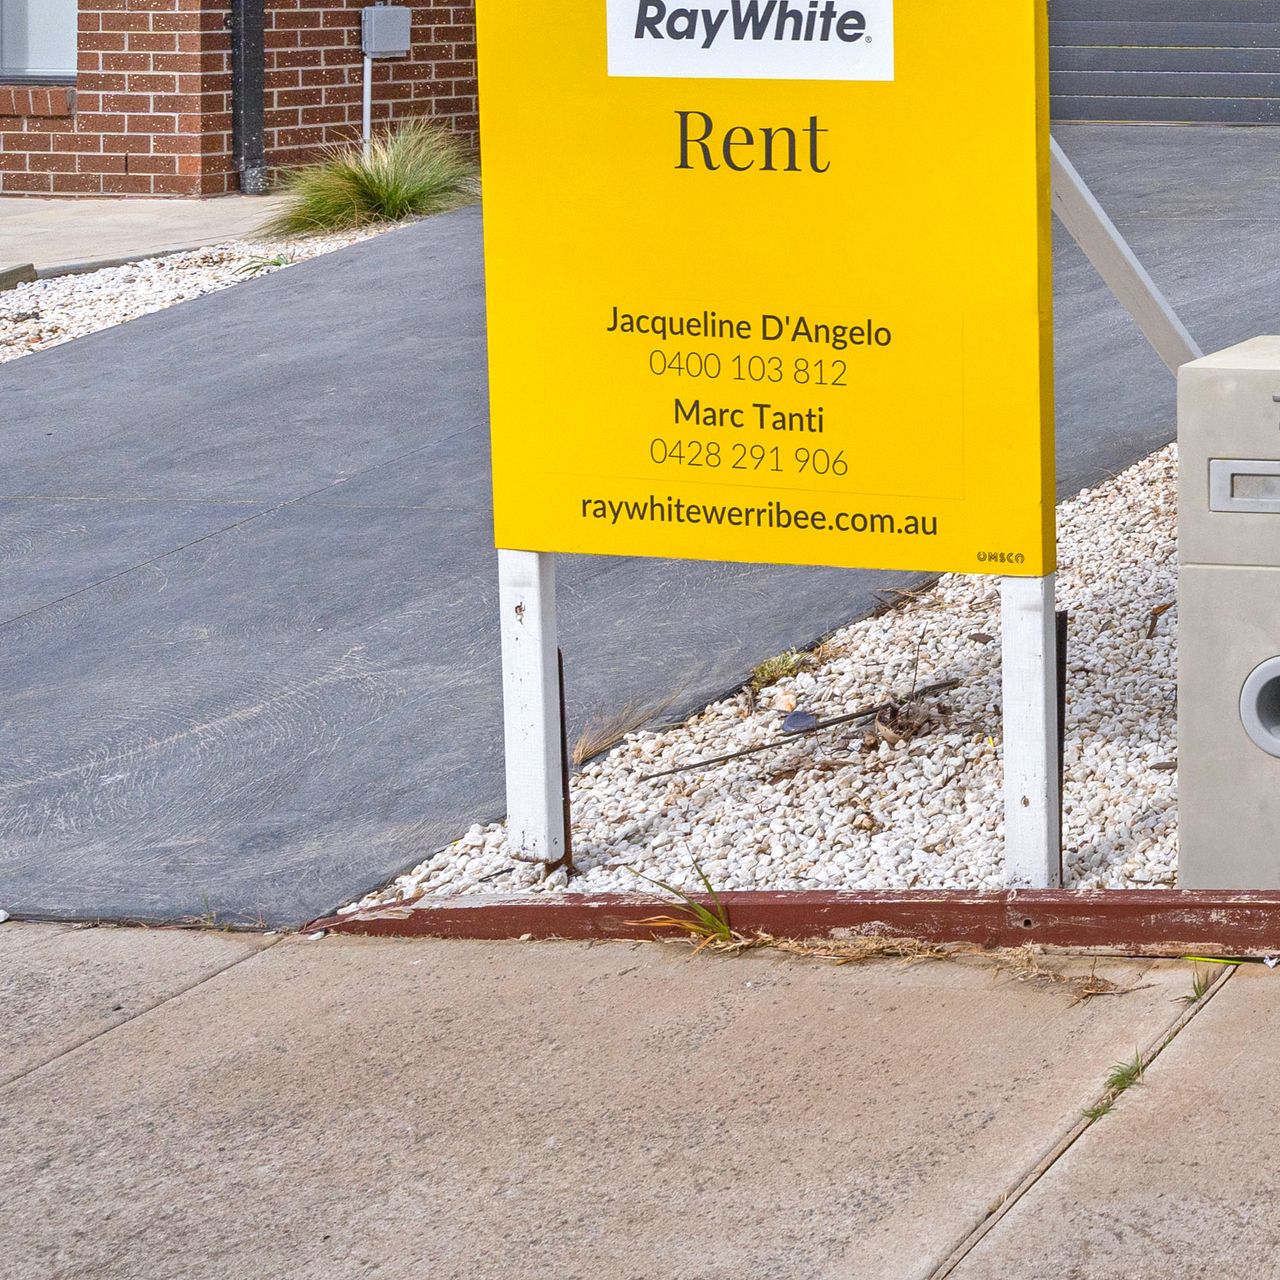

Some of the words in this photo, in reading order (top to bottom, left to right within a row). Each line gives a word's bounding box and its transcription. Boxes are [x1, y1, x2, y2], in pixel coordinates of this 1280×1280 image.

[674, 111, 830, 173] Rent
[606, 306, 751, 340] Jacqueline
[762, 315, 892, 350] D'Angelo
[649, 350, 721, 378] 0400
[733, 355, 783, 382] 103
[794, 358, 847, 385] 812
[674, 399, 744, 427] Marc
[753, 404, 824, 432] Tanti
[650, 439, 721, 467] 0428
[732, 444, 784, 471] 291
[795, 448, 848, 475] 906
[582, 495, 938, 535] raywhitewerribee.com.au
